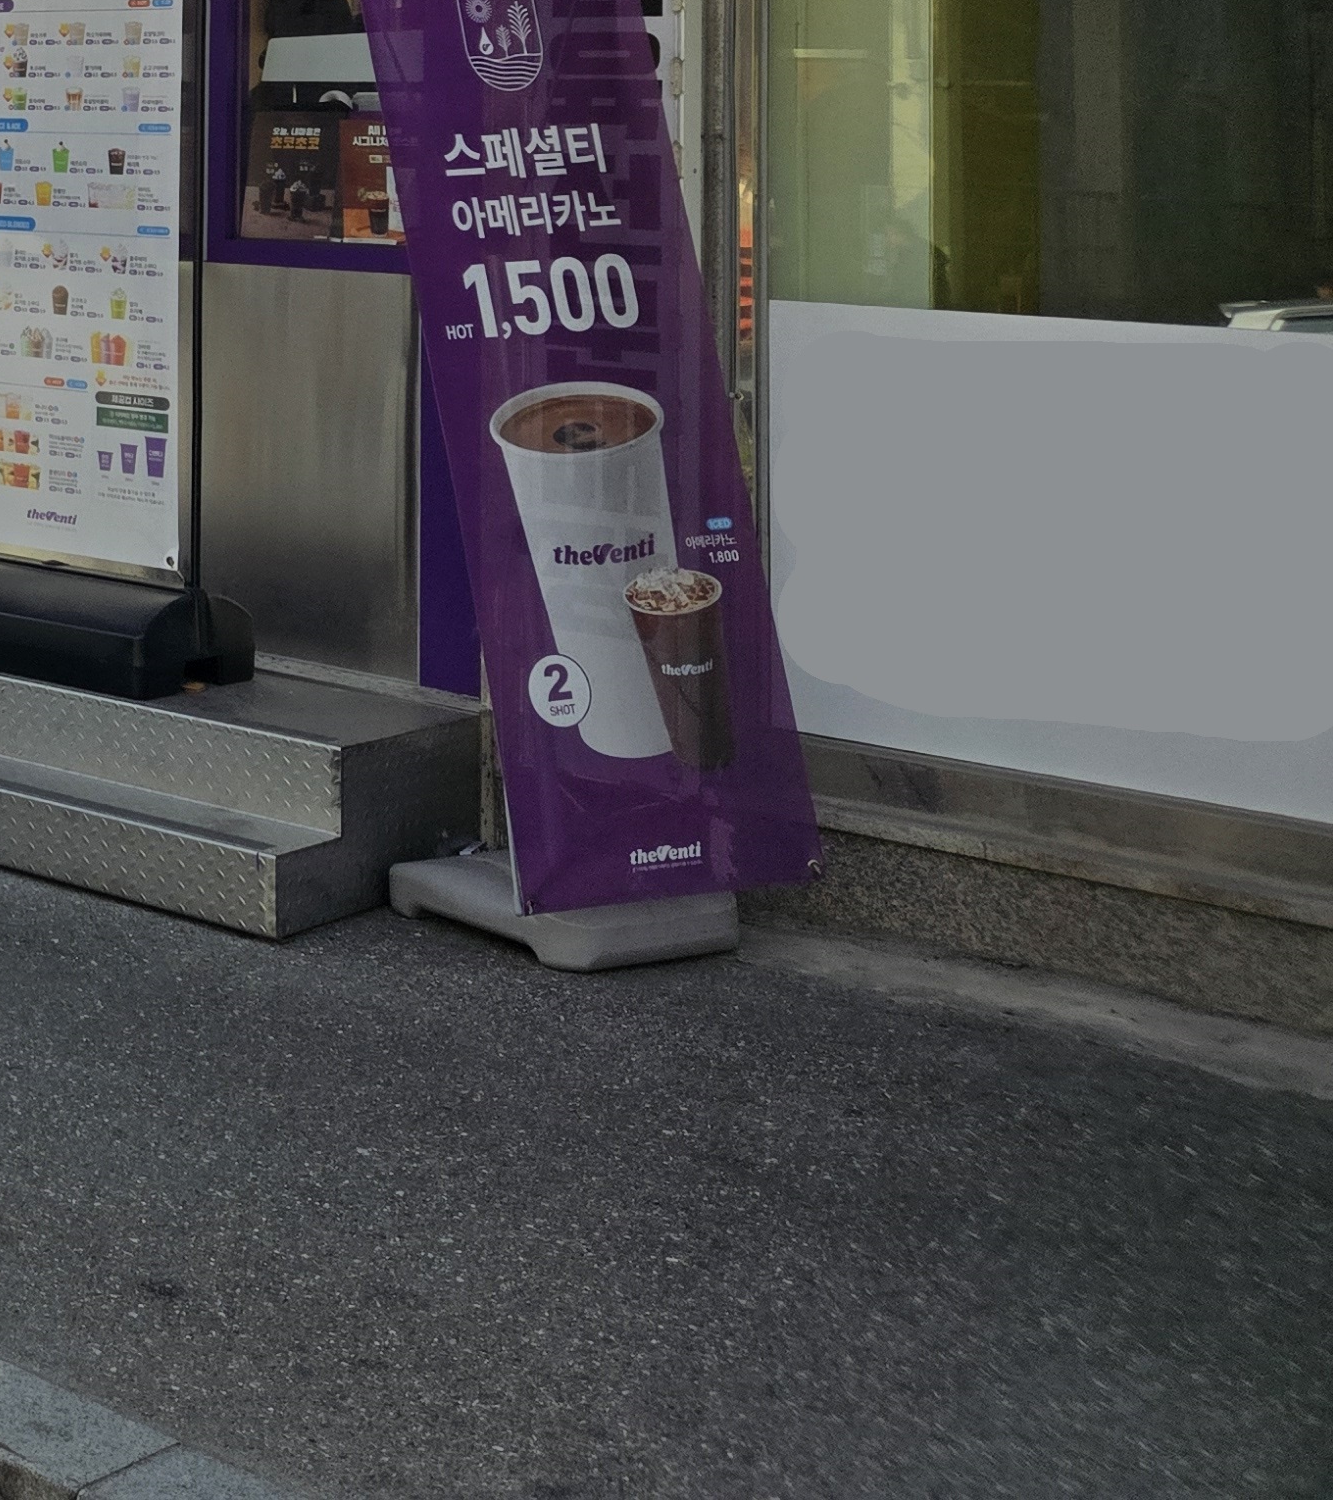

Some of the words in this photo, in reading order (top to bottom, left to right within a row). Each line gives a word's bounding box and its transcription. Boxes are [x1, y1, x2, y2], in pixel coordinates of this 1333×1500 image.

[270, 137, 320, 149] 초코초코
[443, 123, 608, 179] 스페셜티
[451, 191, 621, 239] 아메리카노
[462, 253, 640, 340] 1,500
[445, 323, 474, 341] HOT
[133, 396, 154, 407] 사이즈
[26, 509, 77, 526] theVenti
[708, 518, 731, 529] ICED
[553, 533, 656, 566] theVenti
[685, 533, 737, 551] 아메리카노
[661, 658, 714, 676] theVenti
[543, 663, 574, 702] 2
[549, 703, 576, 717] SHOT
[629, 841, 702, 865] theVenti
